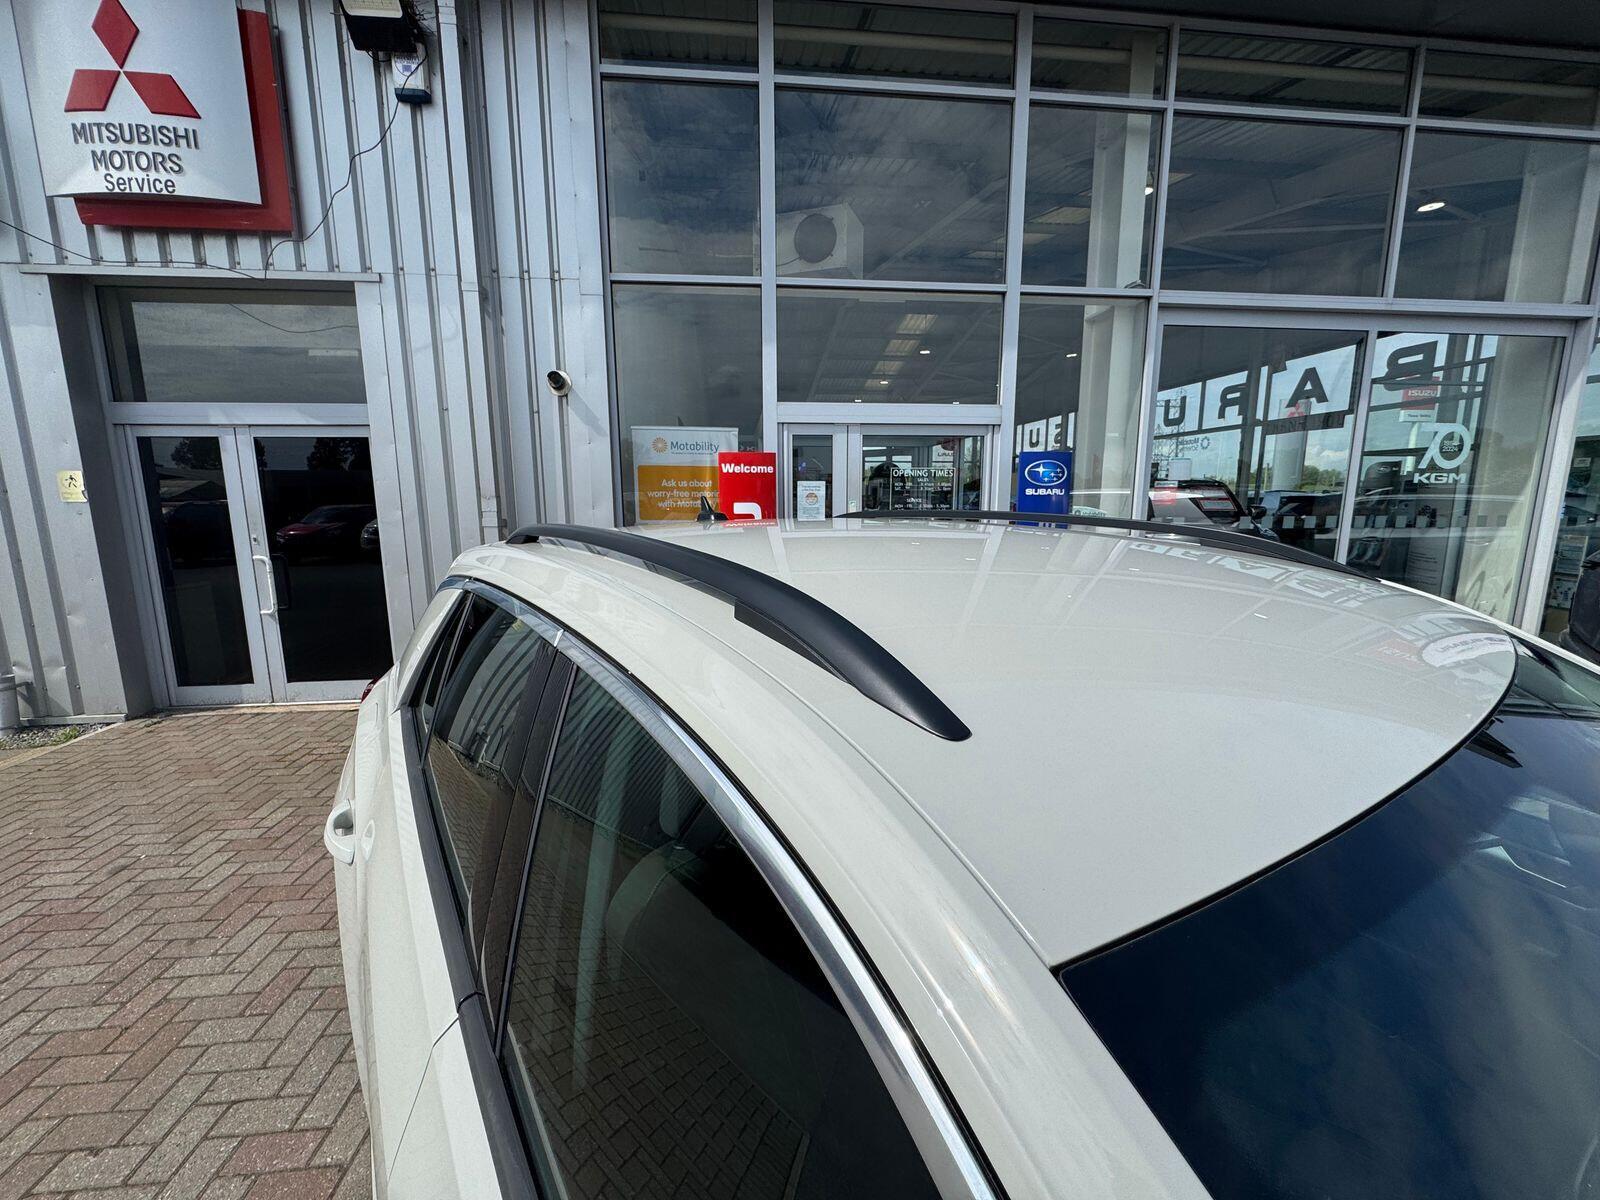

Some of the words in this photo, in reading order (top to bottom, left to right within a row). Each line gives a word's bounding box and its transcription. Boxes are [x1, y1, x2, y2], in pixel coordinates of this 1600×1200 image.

[71, 122, 200, 150] MITSUBISHI
[91, 149, 184, 174] MOTORS
[104, 173, 176, 194] Service
[670, 441, 720, 453] Motability
[721, 463, 774, 474] Welcome
[892, 469, 929, 477] OPENING
[930, 469, 954, 477] TIMES
[661, 479, 677, 487] Ask
[689, 479, 712, 487] about
[1413, 473, 1467, 484] KGM
[647, 489, 690, 499] worry-free
[1025, 488, 1065, 496] SUBARU
